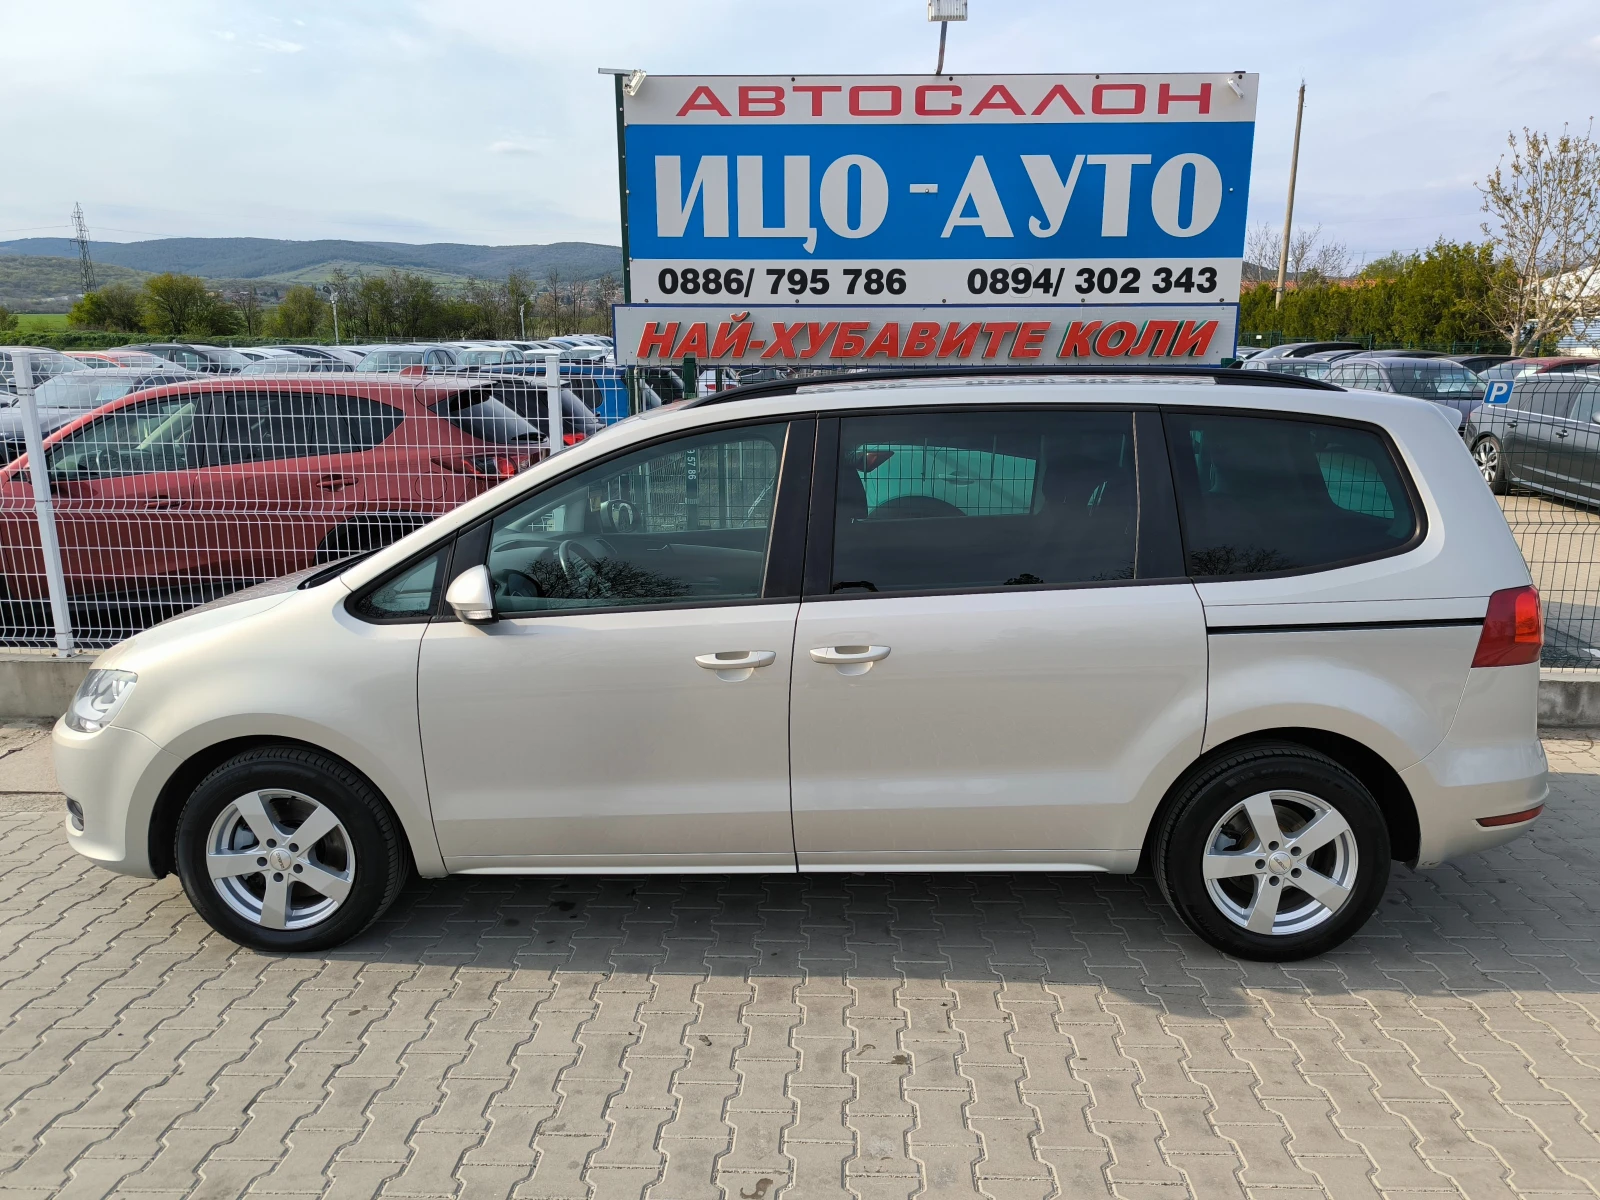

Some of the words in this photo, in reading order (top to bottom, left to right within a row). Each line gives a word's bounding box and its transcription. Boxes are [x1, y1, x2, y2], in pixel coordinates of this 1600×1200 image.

[677, 83, 1211, 116] АВТОСАЛОН
[658, 268, 755, 297] 0886/
[766, 268, 830, 295] 795
[842, 268, 907, 295] 786
[967, 268, 1065, 297] 0894/
[1075, 267, 1141, 294] 302
[1152, 266, 1217, 294] 343
[636, 311, 1051, 359] НАЙ-ХУБАВИТЕ
[1057, 320, 1219, 358] КОЛИ
[1489, 382, 1508, 401] P
[688, 469, 697, 480] 86
